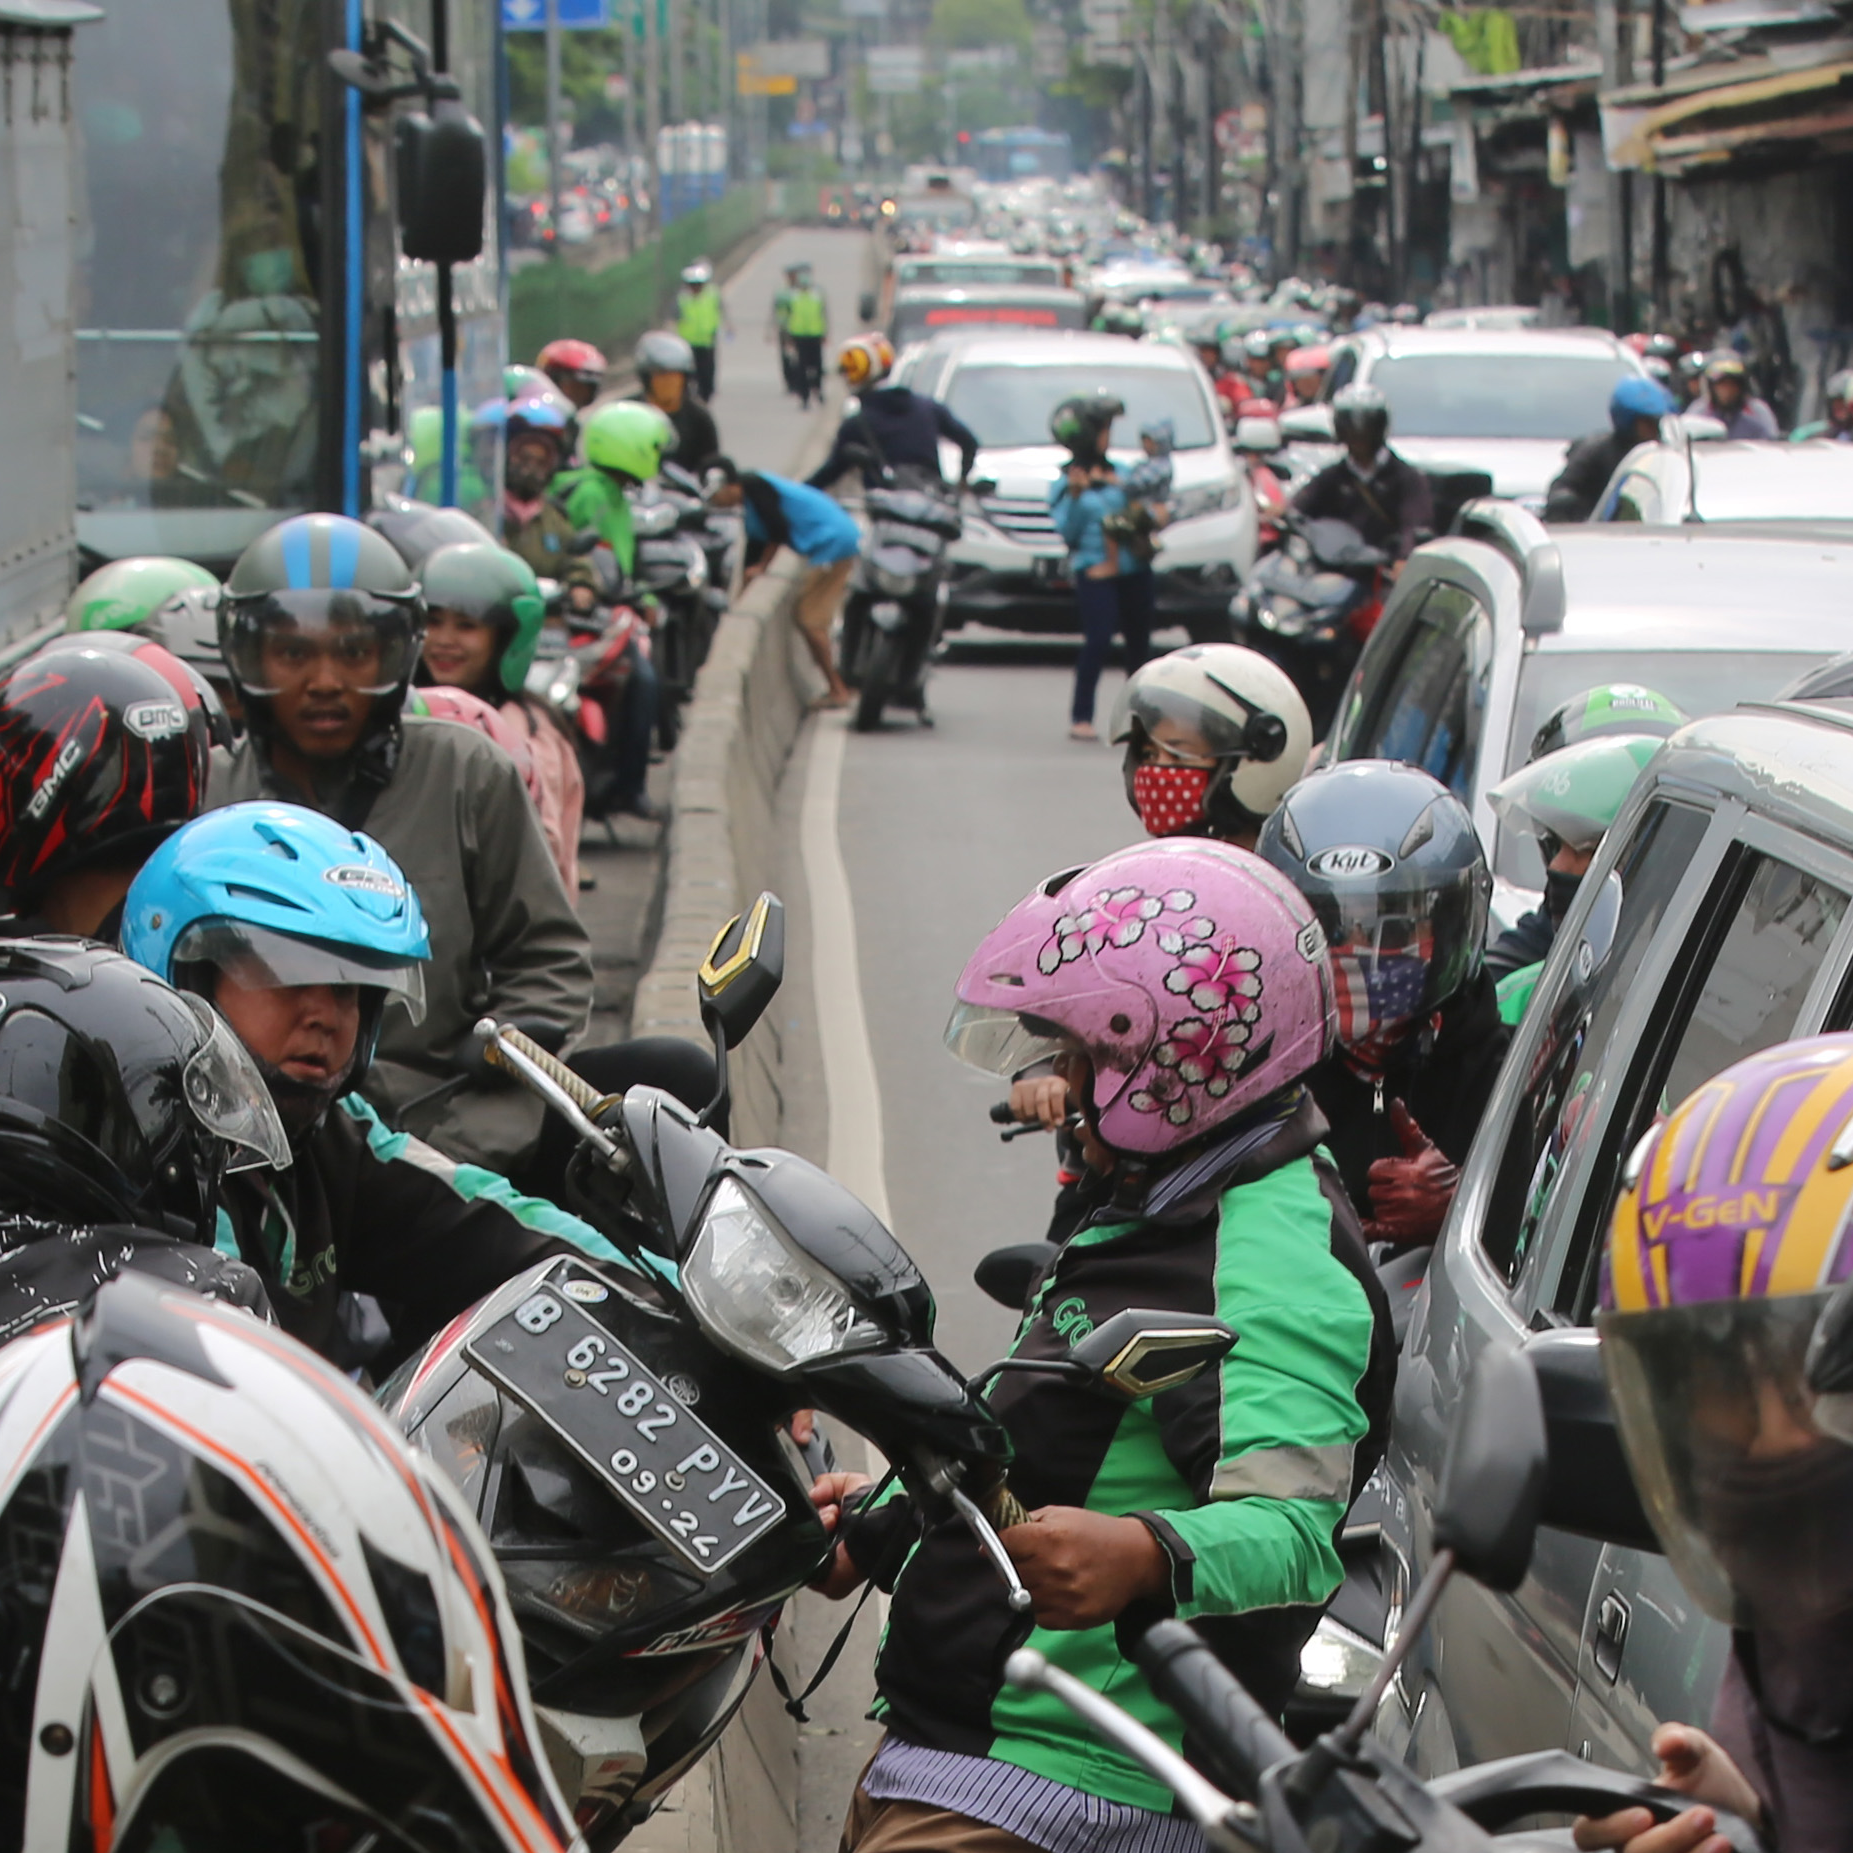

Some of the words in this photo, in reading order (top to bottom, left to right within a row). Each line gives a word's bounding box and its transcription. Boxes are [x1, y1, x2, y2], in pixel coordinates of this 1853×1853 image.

[26, 738, 81, 819] BMC
[1053, 1297, 1094, 1348] Gra
[514, 1293, 563, 1334] B
[566, 1335, 678, 1443] 6282
[675, 1443, 773, 1527] PYV
